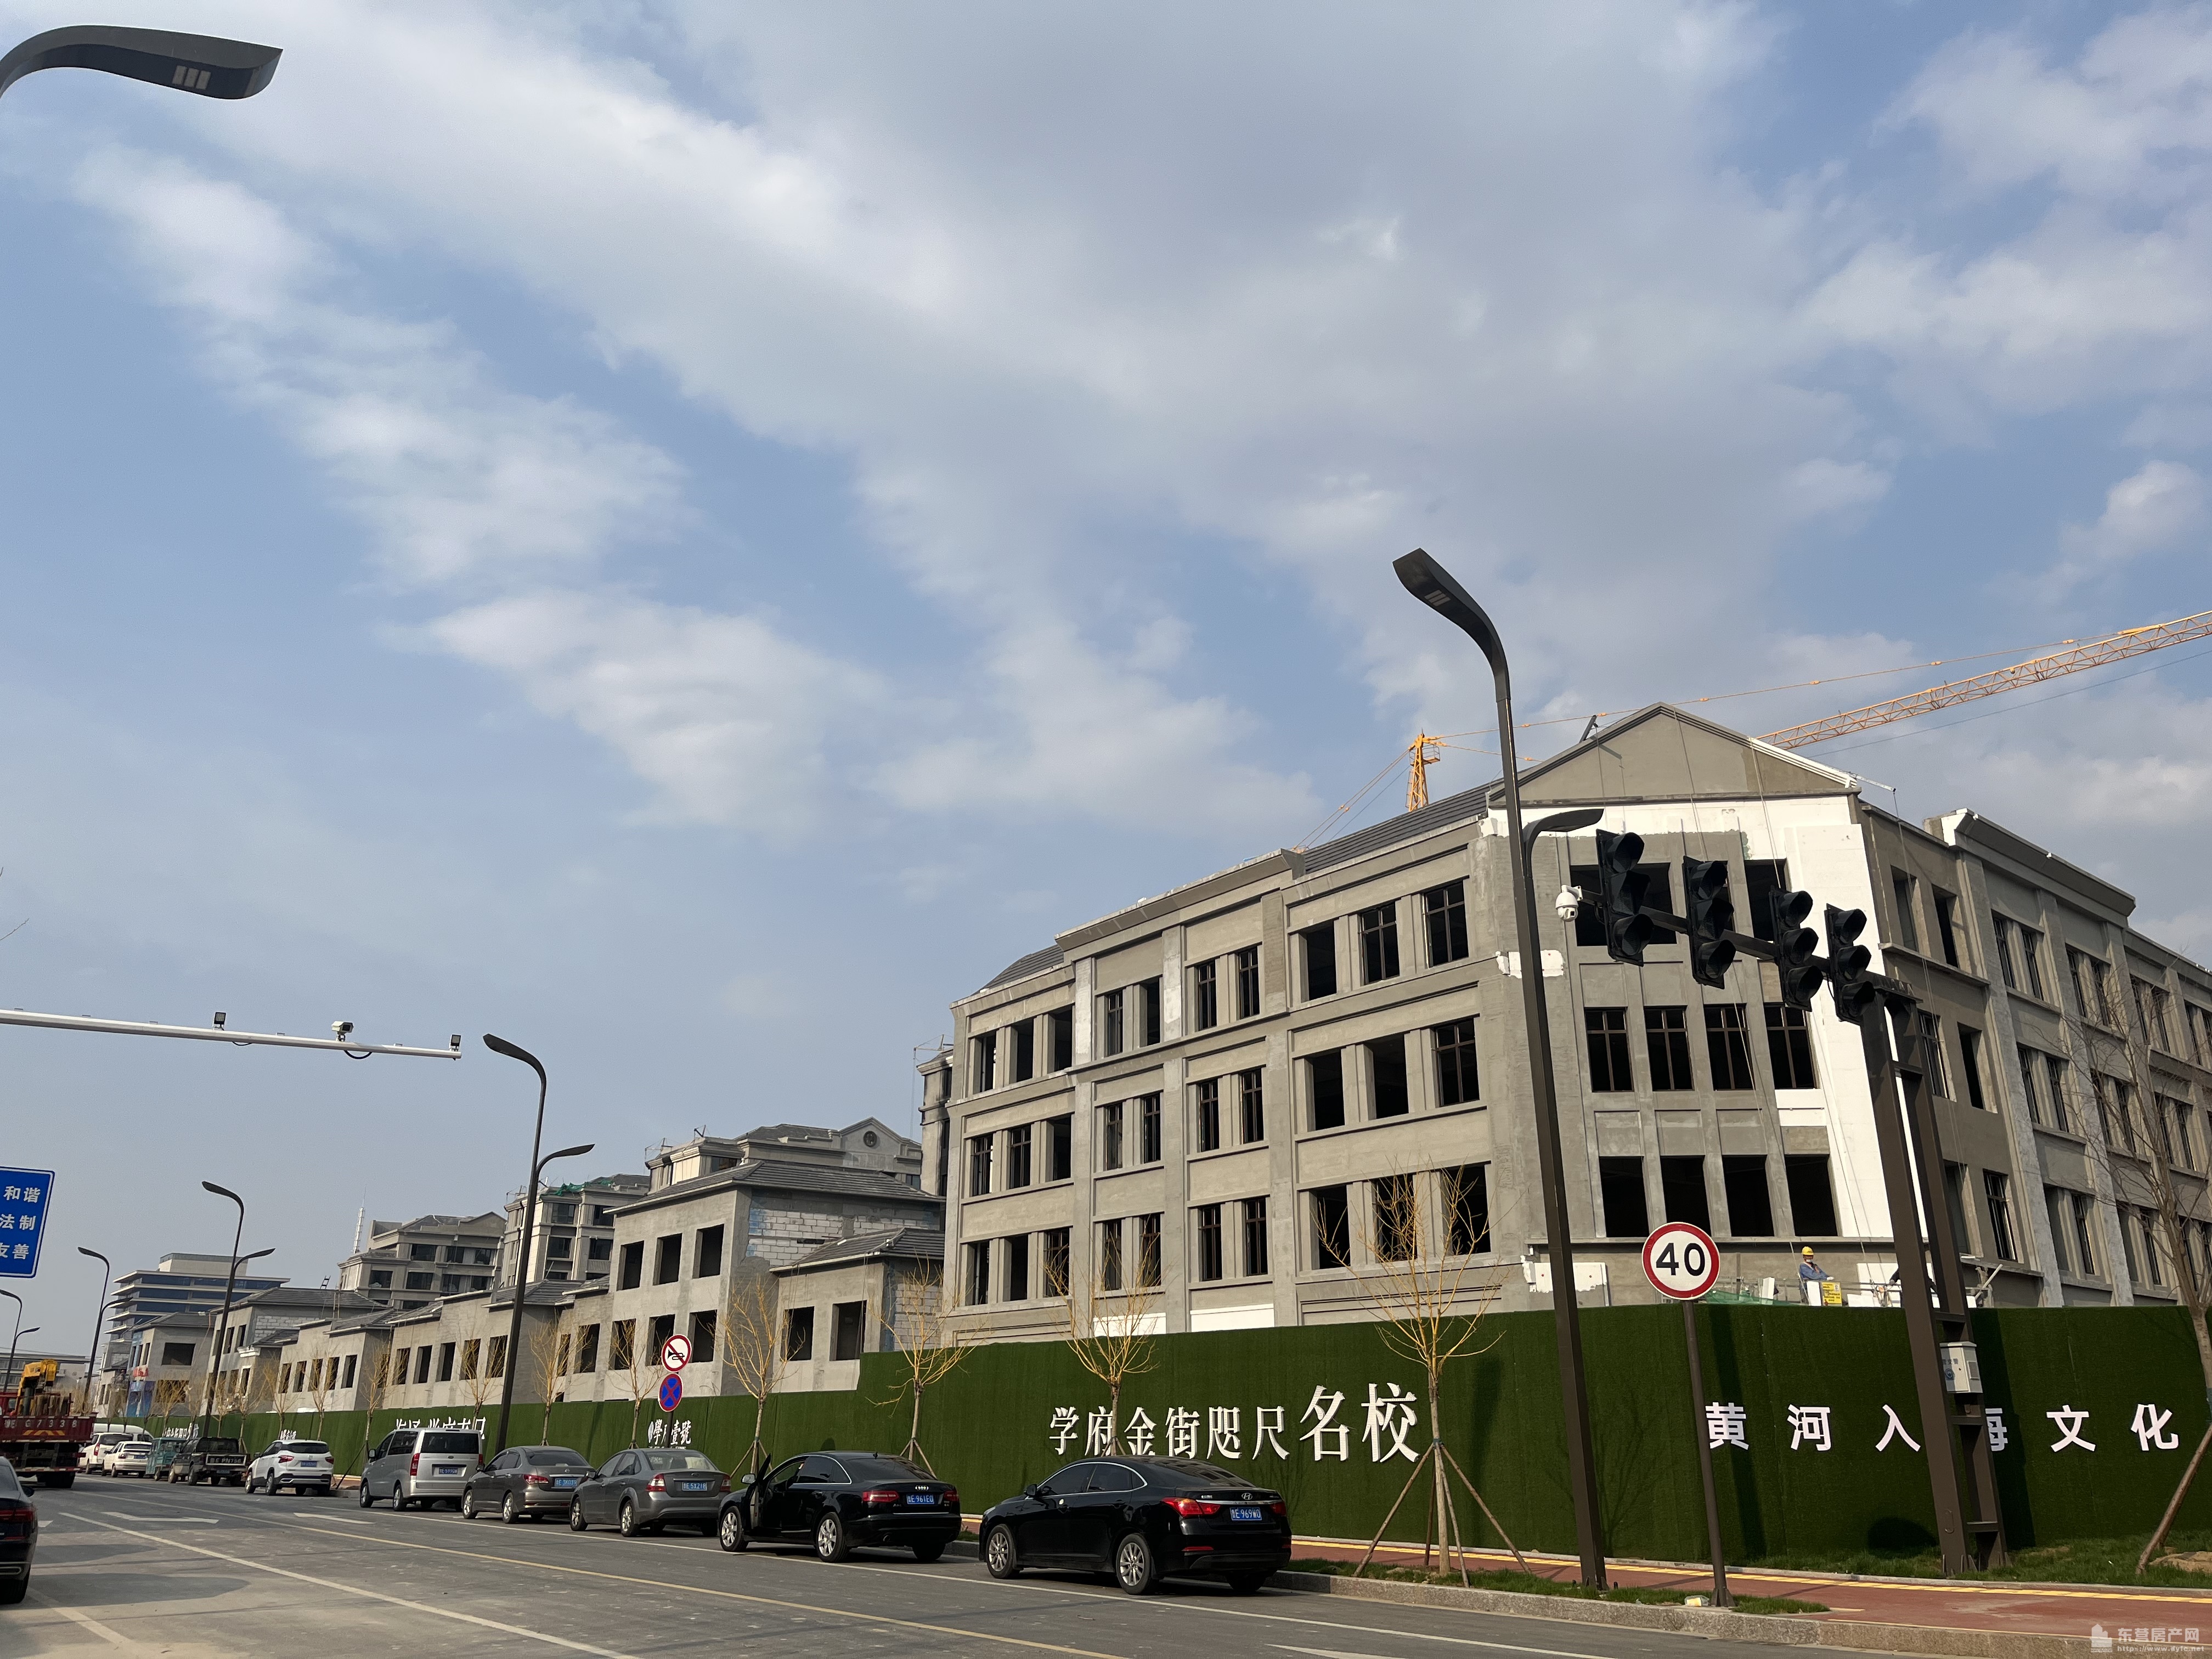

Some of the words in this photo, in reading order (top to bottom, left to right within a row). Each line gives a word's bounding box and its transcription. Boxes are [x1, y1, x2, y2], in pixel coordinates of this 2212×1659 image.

[3, 1186, 41, 1203] 和谐
[0, 1214, 36, 1231] 法制
[0, 1242, 29, 1260] 友善
[1656, 1242, 1706, 1276] 40
[1049, 1382, 1421, 1463] 学府金街咫尺名校
